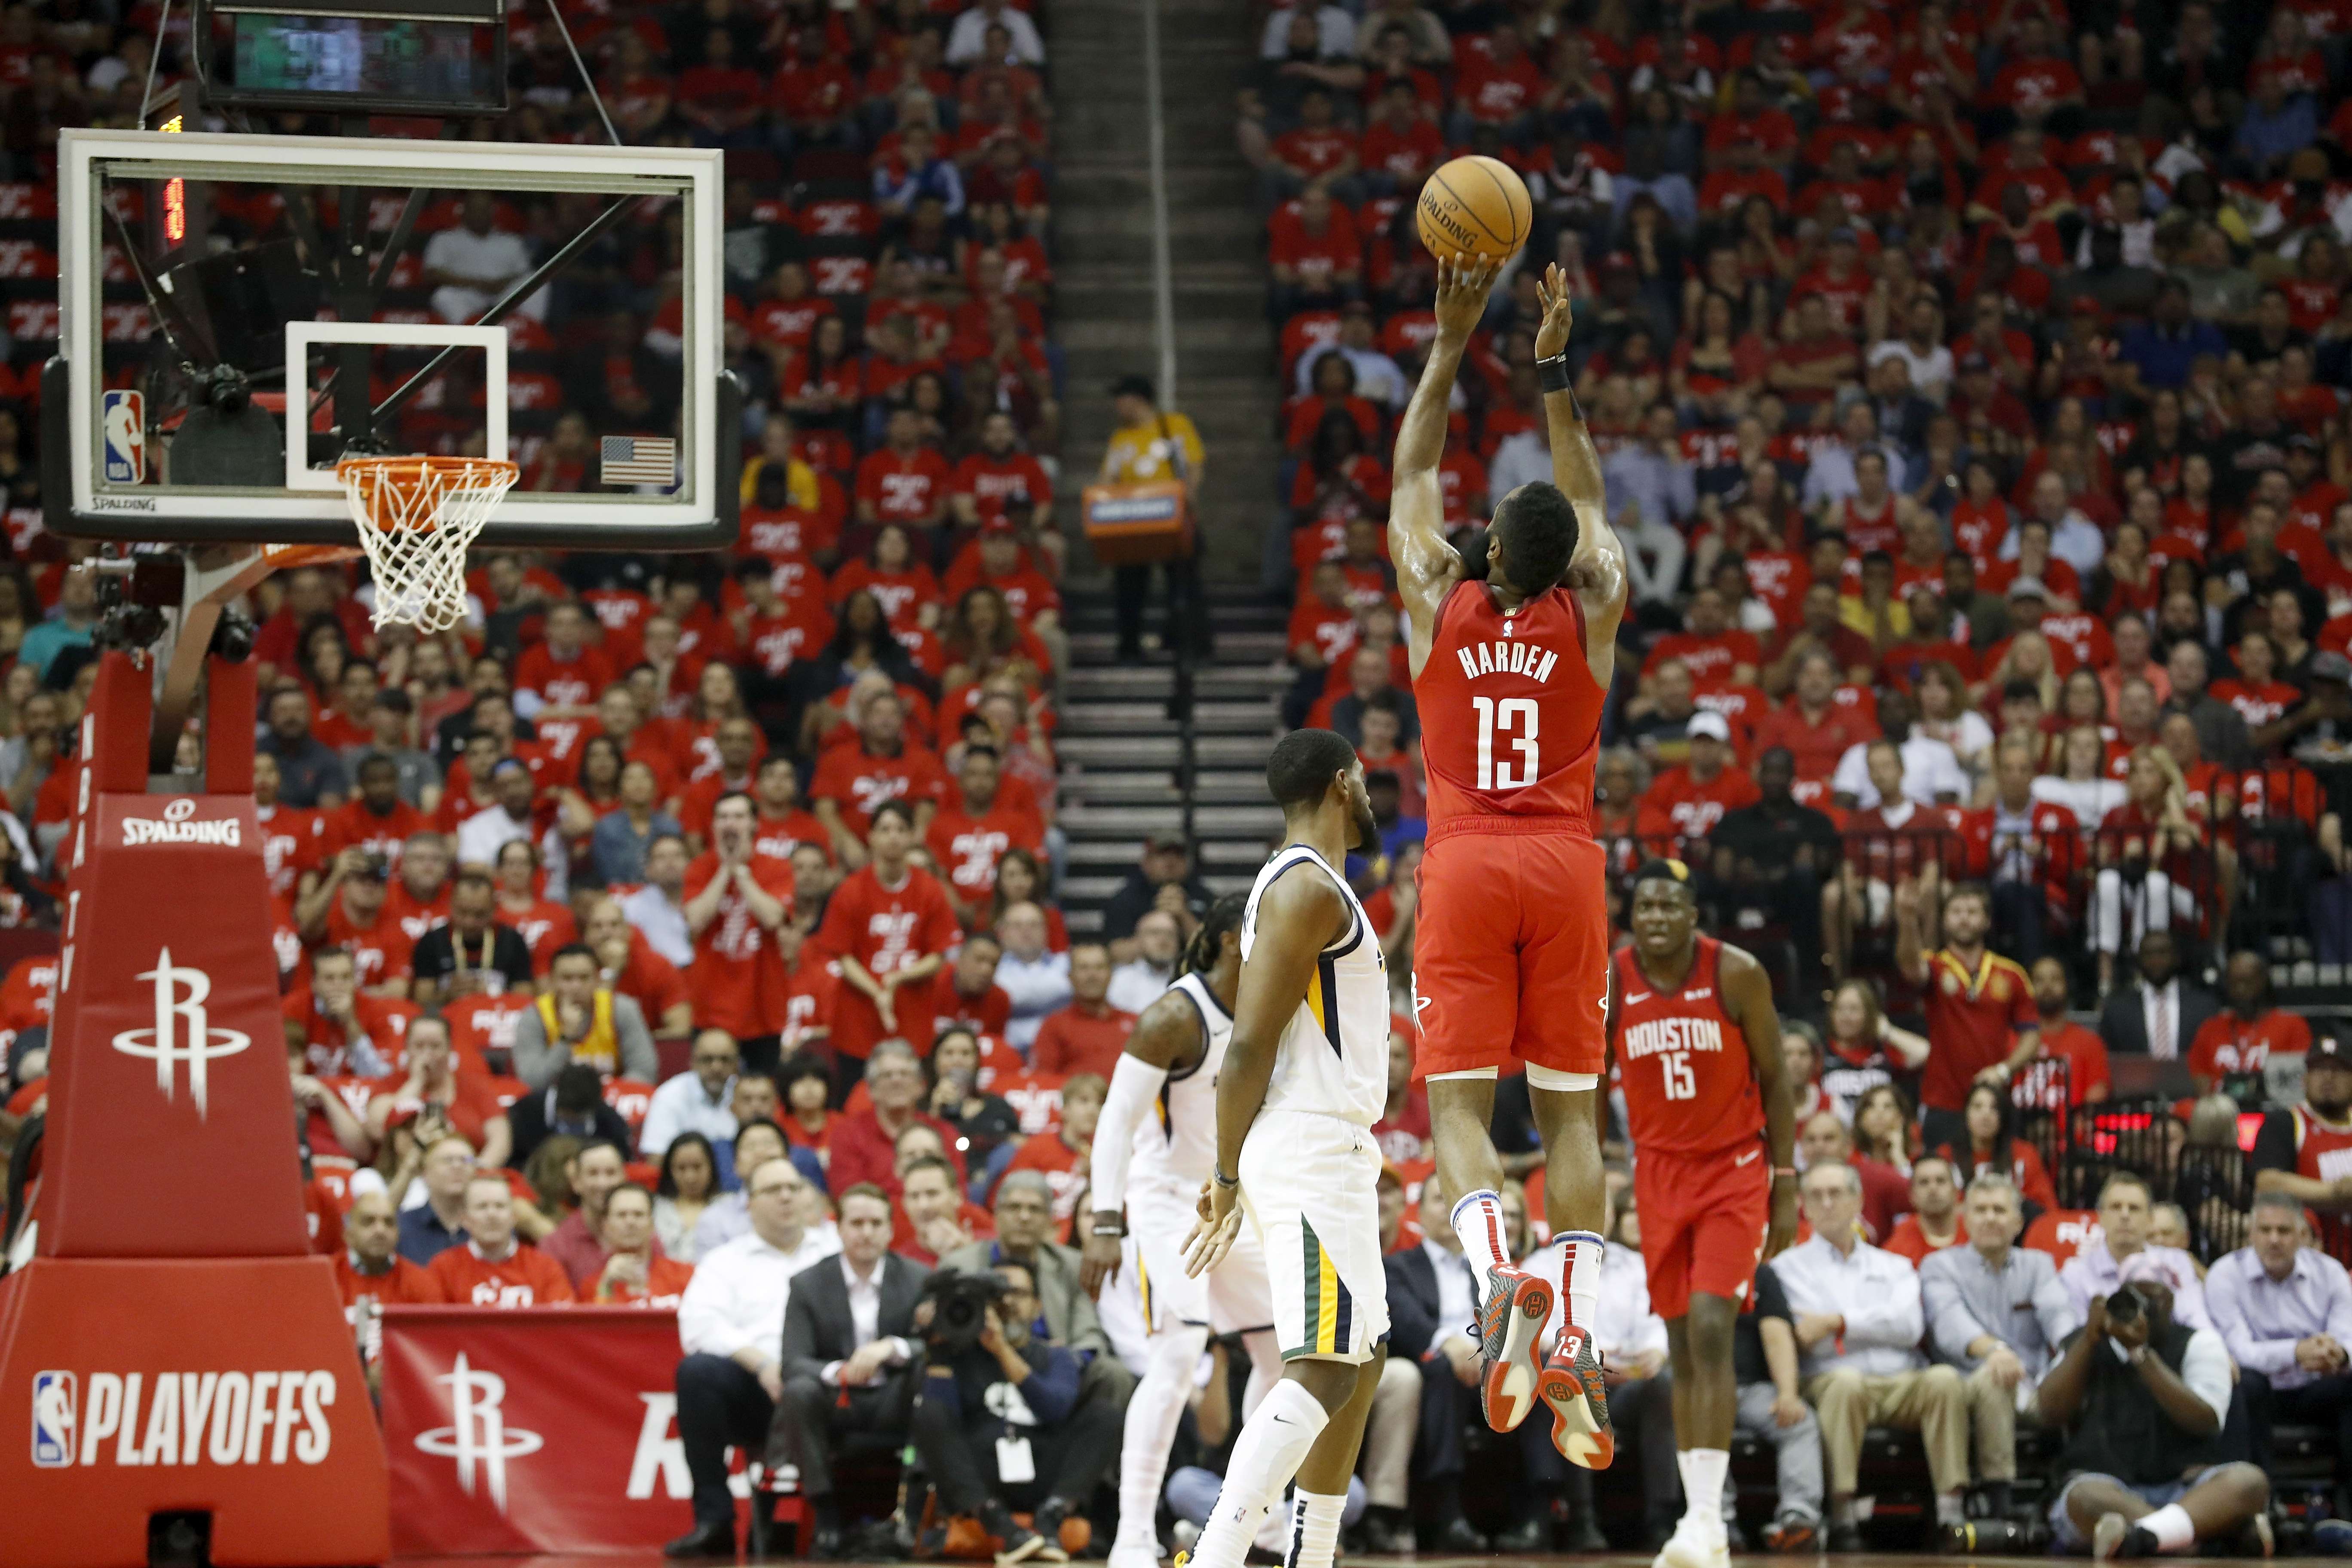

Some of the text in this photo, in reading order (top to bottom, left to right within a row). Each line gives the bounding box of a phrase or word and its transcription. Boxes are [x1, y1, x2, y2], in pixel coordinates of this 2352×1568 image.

[92, 497, 156, 511] SPALDING
[1457, 641, 1559, 684] HARDEN
[1473, 696, 1539, 790] 13
[122, 817, 241, 847] SPALDING
[1625, 1016, 1722, 1060] HOUSTON
[1659, 1050, 1696, 1100] 15
[1554, 1335, 1582, 1359] 13
[80, 1370, 337, 1466] PLAYOFFS
